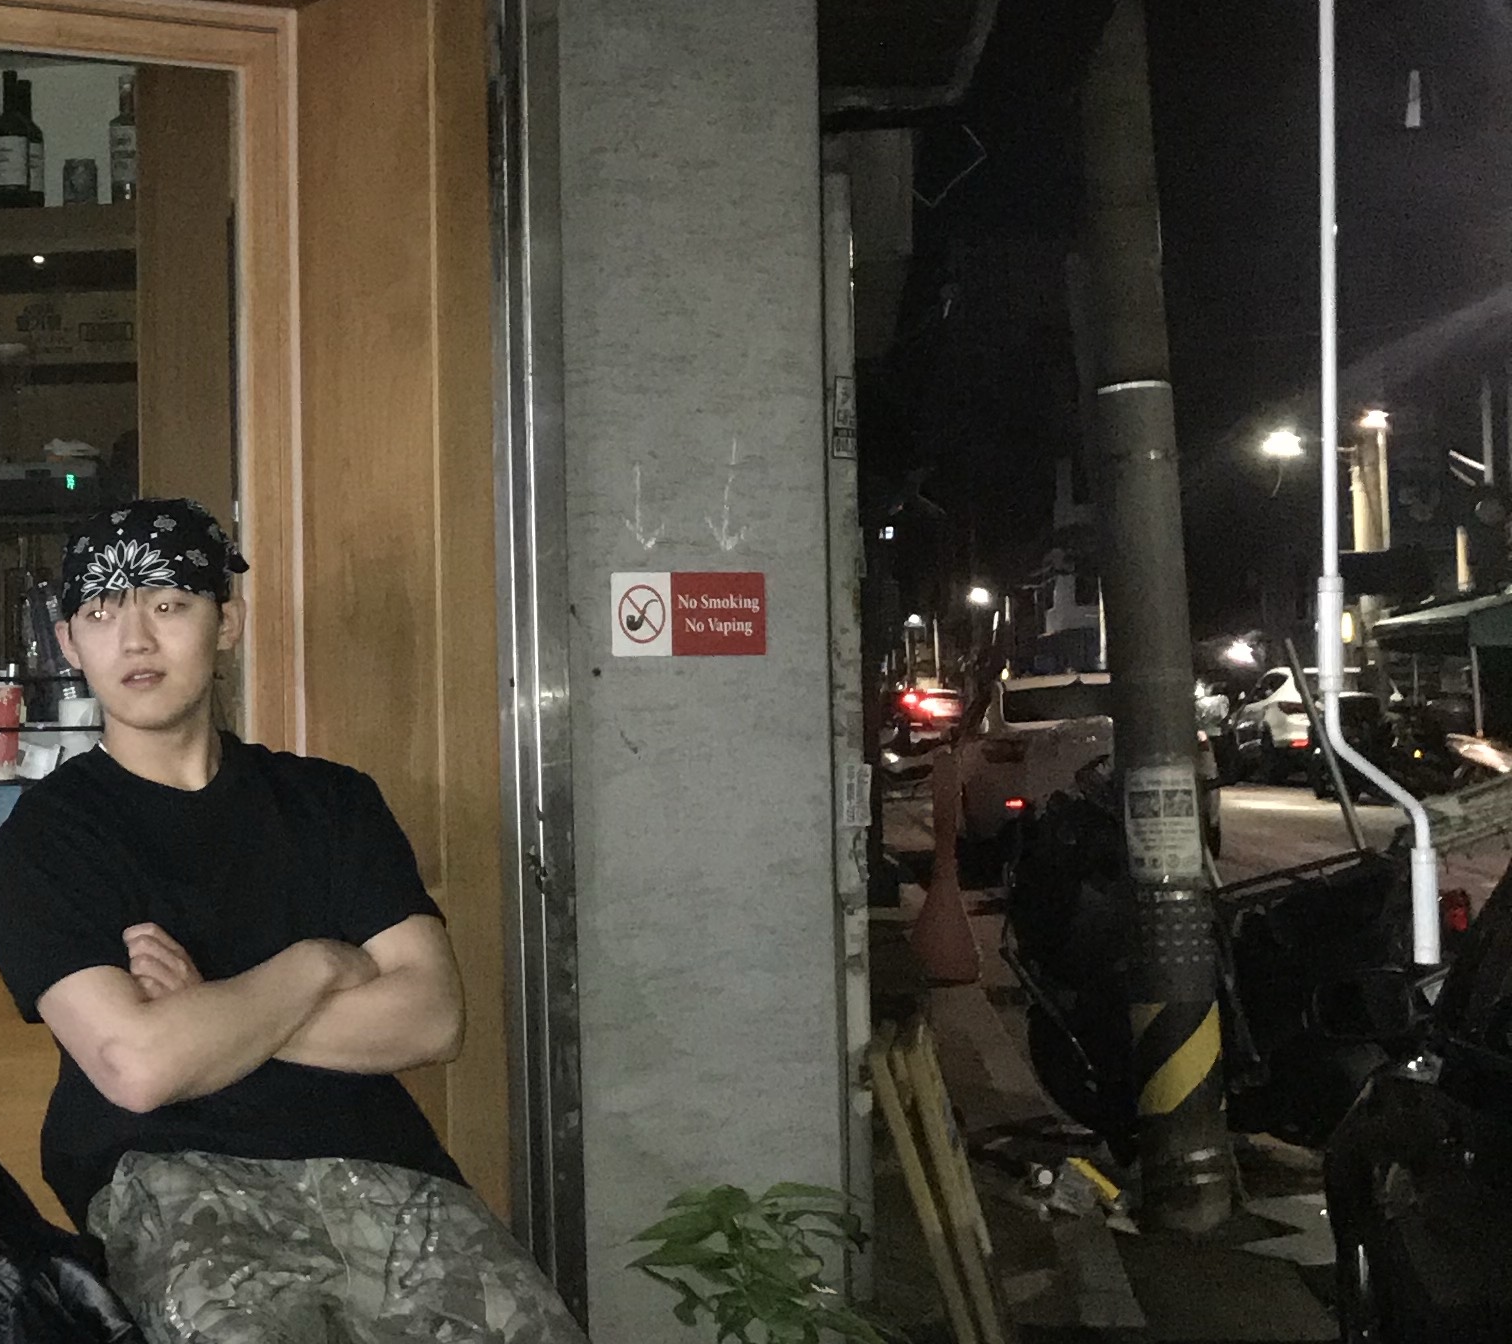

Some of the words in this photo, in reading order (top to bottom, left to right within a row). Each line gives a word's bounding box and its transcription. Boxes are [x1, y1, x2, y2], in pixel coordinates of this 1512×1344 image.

[677, 594, 698, 609] No
[700, 593, 760, 613] Smoking
[684, 617, 705, 633] No
[707, 617, 753, 636] Vaping
